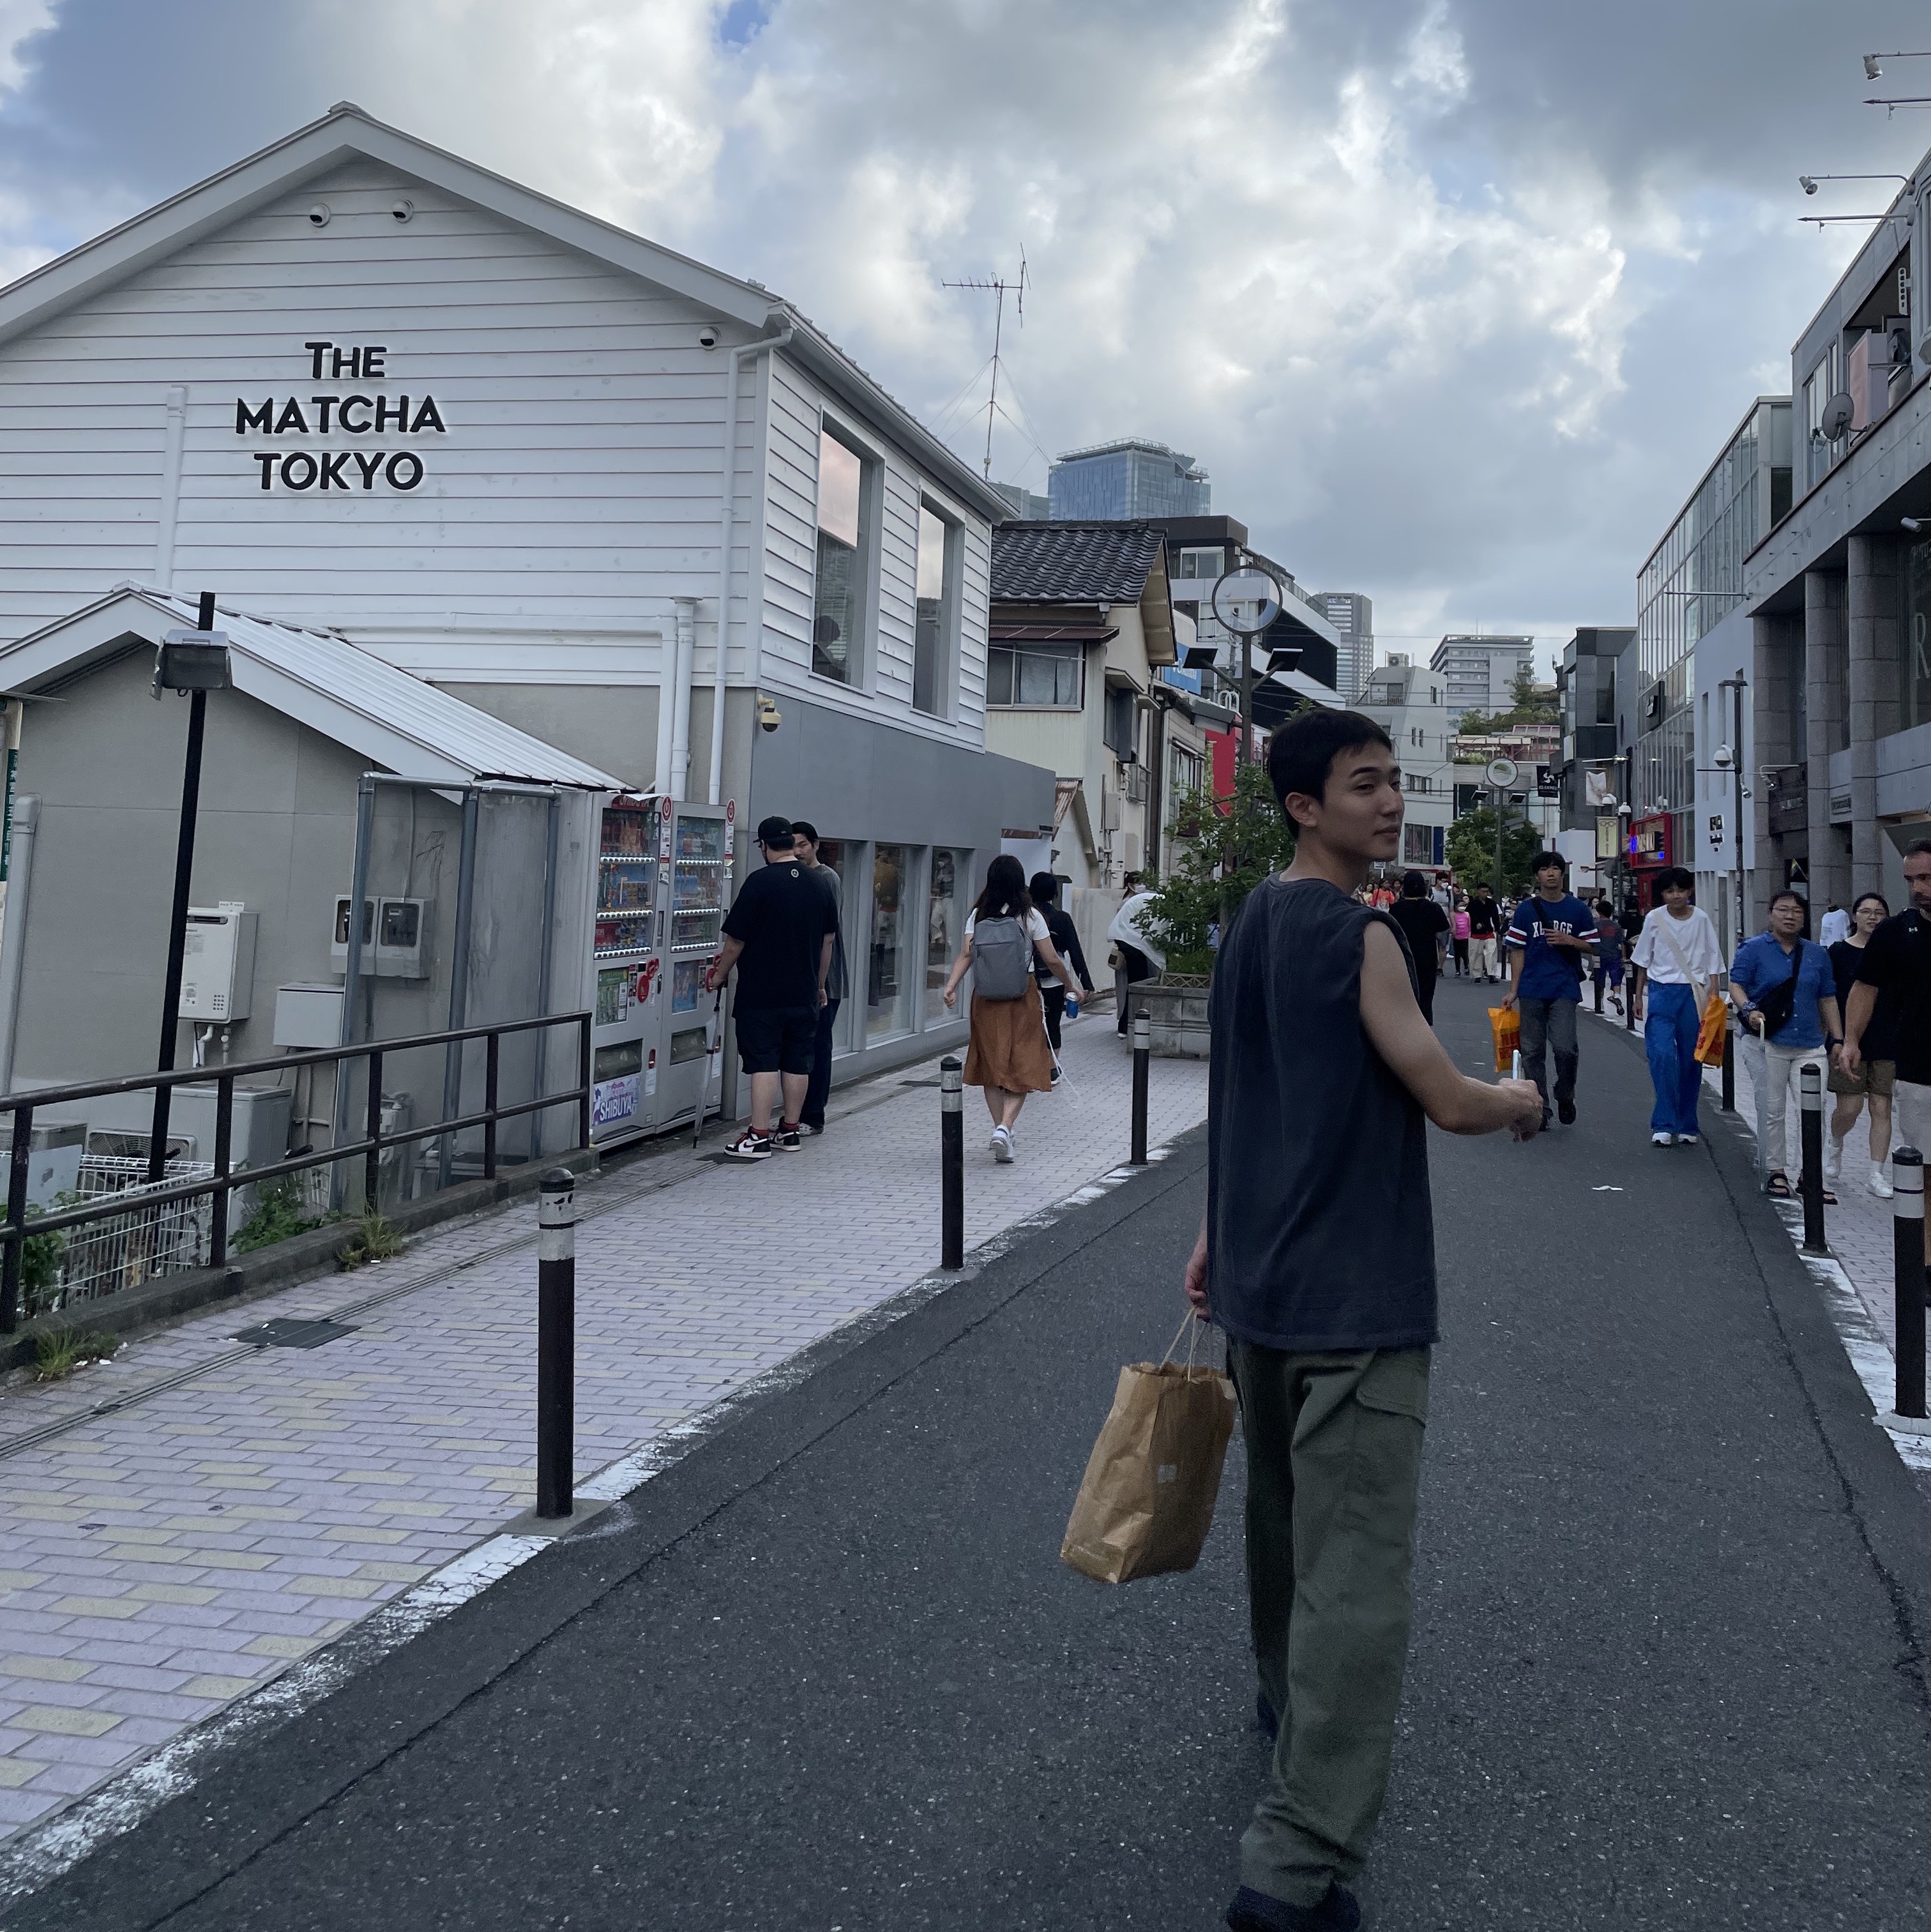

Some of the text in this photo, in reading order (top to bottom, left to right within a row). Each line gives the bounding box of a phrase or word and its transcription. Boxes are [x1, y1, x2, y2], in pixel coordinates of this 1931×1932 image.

[305, 342, 387, 379] THE
[236, 395, 446, 434] MATCHA
[254, 452, 423, 491] TOKYO
[1533, 920, 1573, 938] XLRGE
[600, 1095, 632, 1121] SHIBUYA
